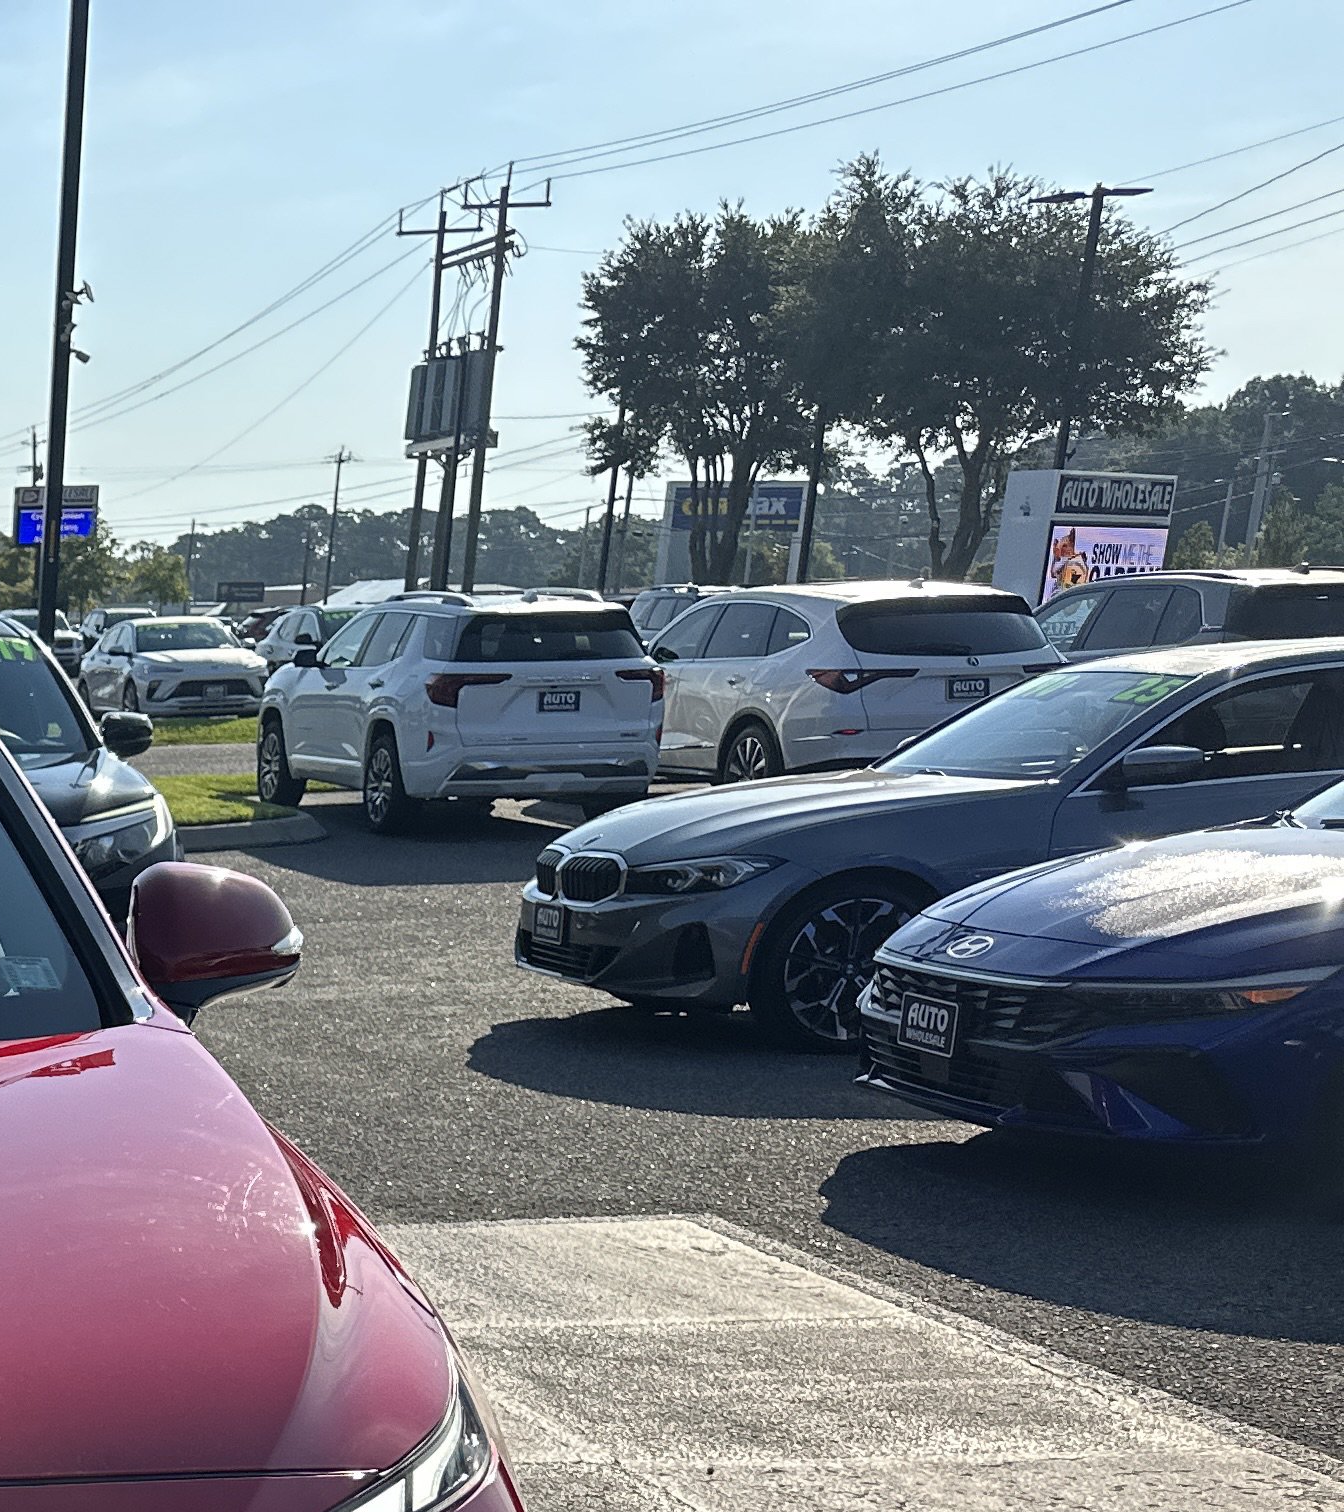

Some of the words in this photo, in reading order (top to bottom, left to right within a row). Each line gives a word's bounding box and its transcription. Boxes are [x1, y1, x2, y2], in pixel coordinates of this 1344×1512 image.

[1061, 480, 1099, 509] AUTO
[1100, 482, 1173, 511] WHOLESALE
[1091, 543, 1122, 565] SHOW
[953, 679, 985, 692] AUTO
[1112, 676, 1186, 703] 25
[543, 692, 576, 705] AUTO
[537, 907, 560, 928] AUTO
[907, 1002, 949, 1033] AUTO
